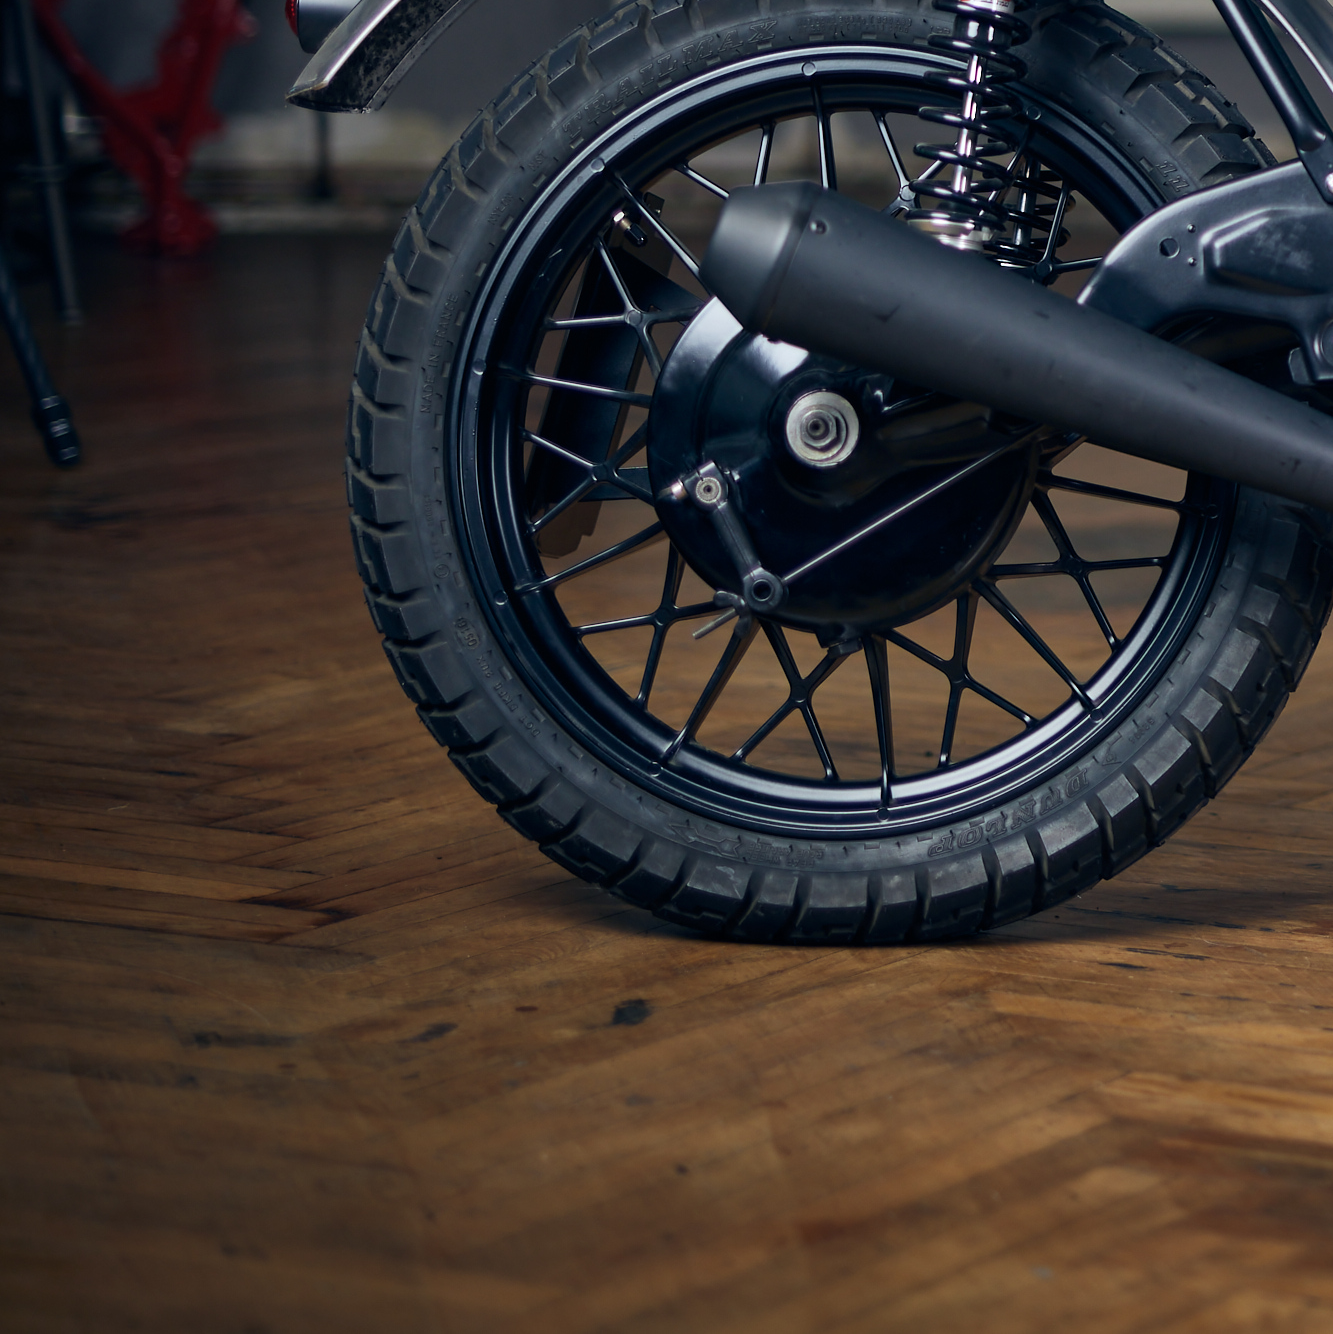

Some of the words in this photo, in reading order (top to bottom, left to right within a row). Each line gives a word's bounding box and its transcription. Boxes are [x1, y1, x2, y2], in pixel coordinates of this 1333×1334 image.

[562, 20, 778, 139] TRAILMAX
[432, 294, 459, 348] FRANCE
[428, 353, 440, 368] IN
[420, 375, 435, 414] MADE
[928, 768, 1089, 857] DUNLOP
